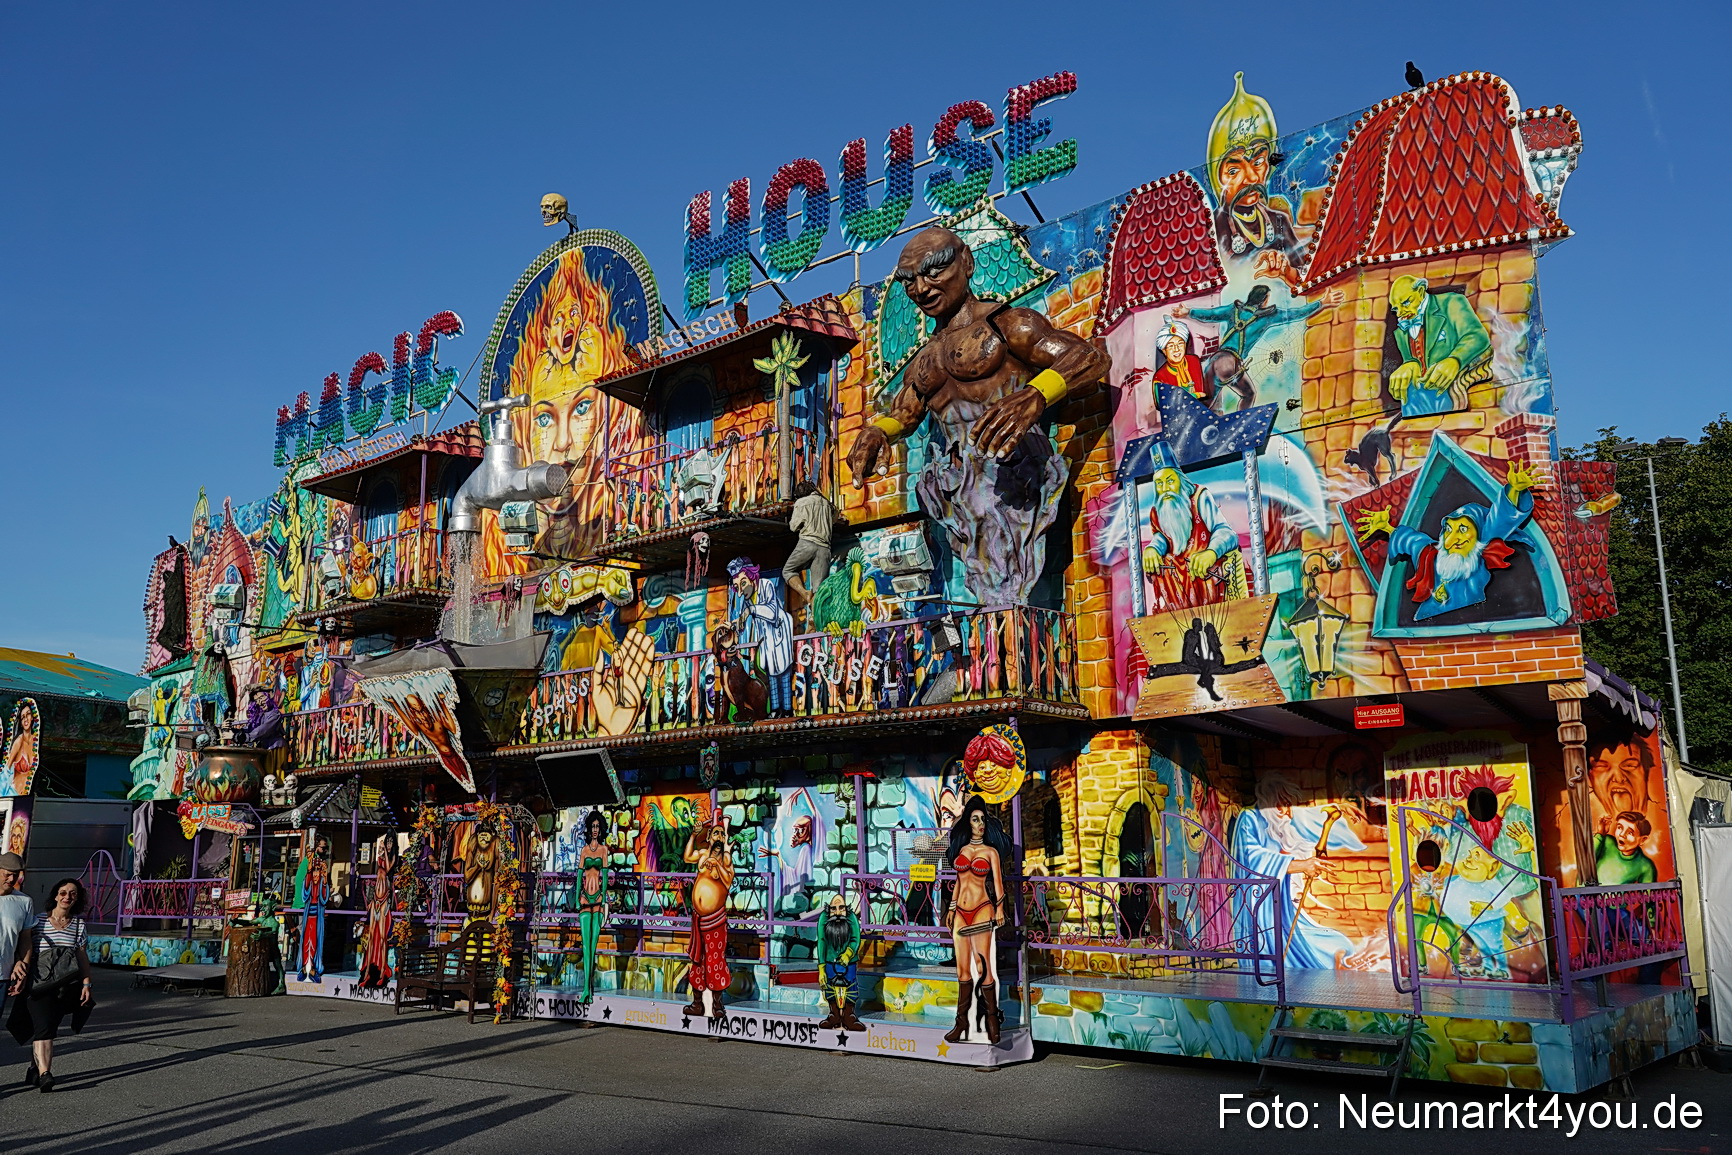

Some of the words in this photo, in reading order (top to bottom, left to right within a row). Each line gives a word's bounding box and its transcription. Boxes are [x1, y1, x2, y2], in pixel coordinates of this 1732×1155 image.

[273, 309, 465, 469] MAGIC
[683, 69, 1078, 322] HOUSE
[636, 309, 735, 360] MAGISCH
[318, 430, 408, 473] PHANTASTISCH
[796, 643, 898, 689] GRUSEL
[533, 677, 591, 728] SPASS
[1371, 707, 1400, 716] AUSGANG
[326, 708, 378, 746] LACHEN
[1389, 767, 1465, 806] MAGIC
[206, 818, 238, 830] EINGANG
[349, 984, 380, 1001] MAGIC
[549, 998, 591, 1018] HOUSE
[624, 1006, 667, 1025] gruseln
[707, 1013, 757, 1038] MAGIC
[762, 1018, 819, 1045] HOUSE
[866, 1028, 917, 1053] lachen
